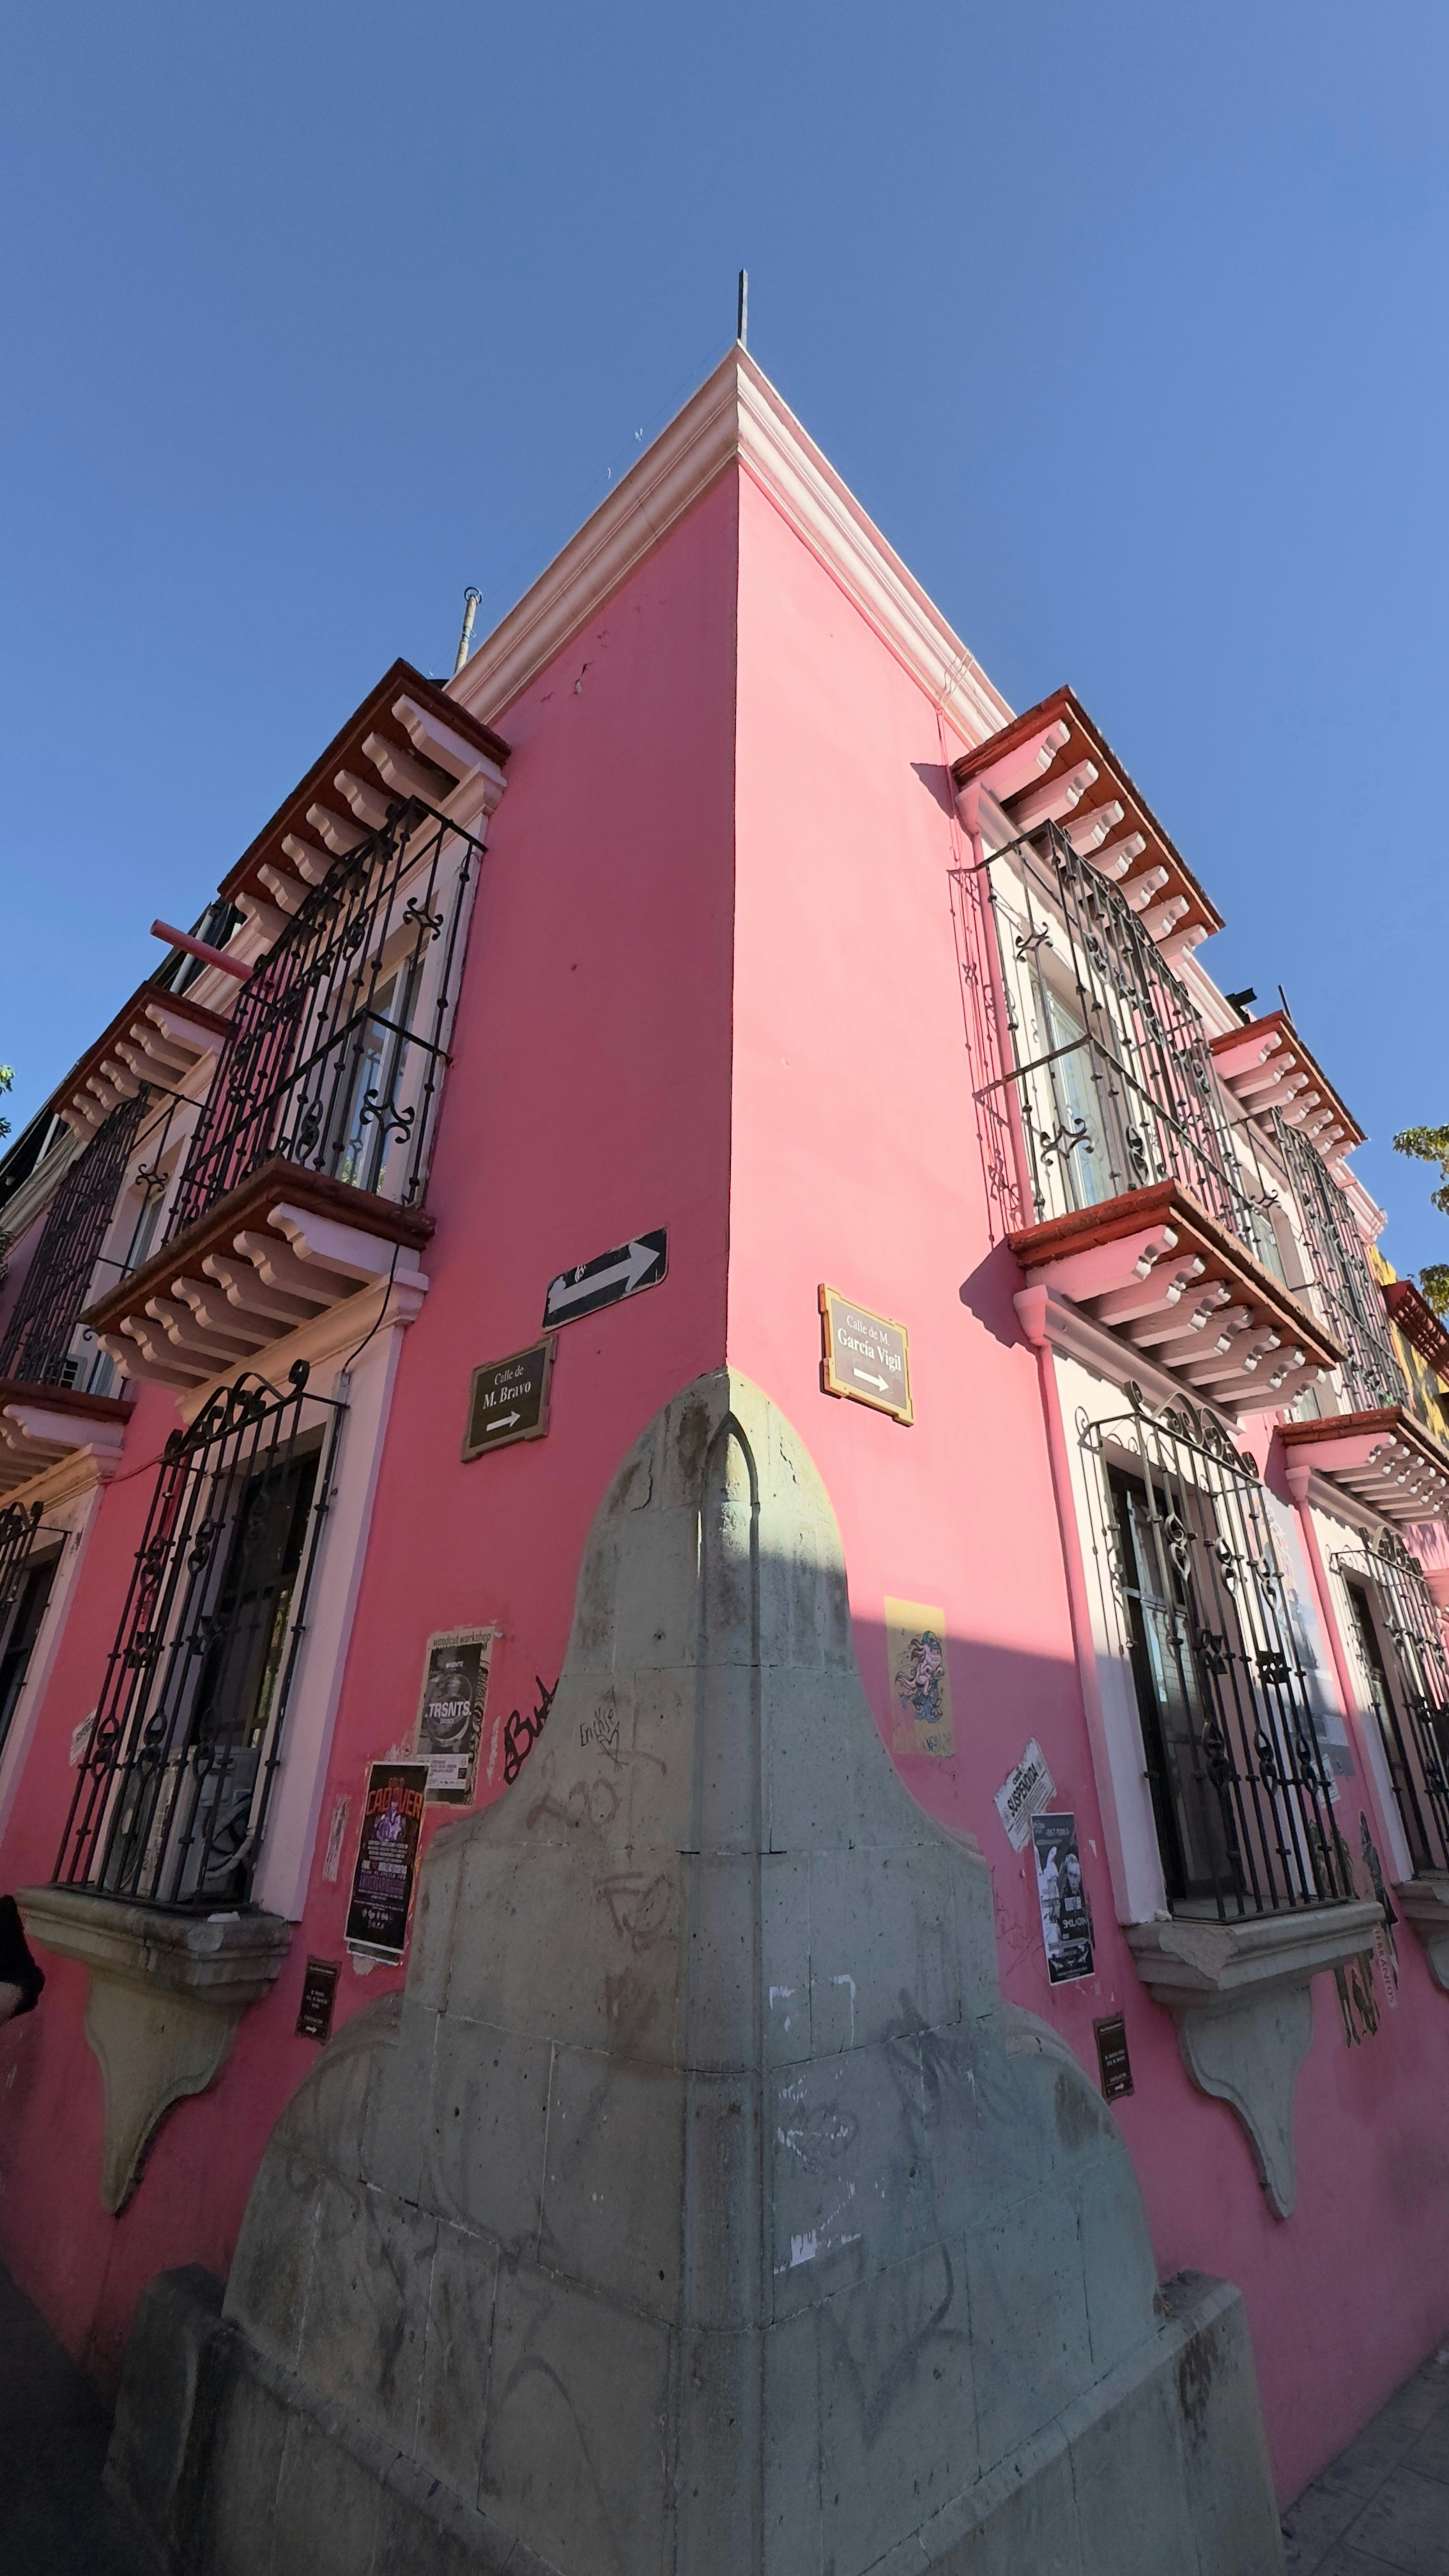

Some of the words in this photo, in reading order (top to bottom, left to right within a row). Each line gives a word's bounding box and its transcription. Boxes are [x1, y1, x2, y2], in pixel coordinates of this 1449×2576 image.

[847, 1315, 867, 1335] Calle
[868, 1326, 878, 1340] de
[879, 1330, 891, 1346] M.
[838, 1329, 875, 1360] García
[877, 1346, 902, 1372] Vigil
[494, 1369, 514, 1386] Calle
[514, 1365, 524, 1377] de
[483, 1392, 497, 1409] M.
[500, 1381, 531, 1404] Bravo
[1007, 1763, 1039, 1818] SUSPENDIDA
